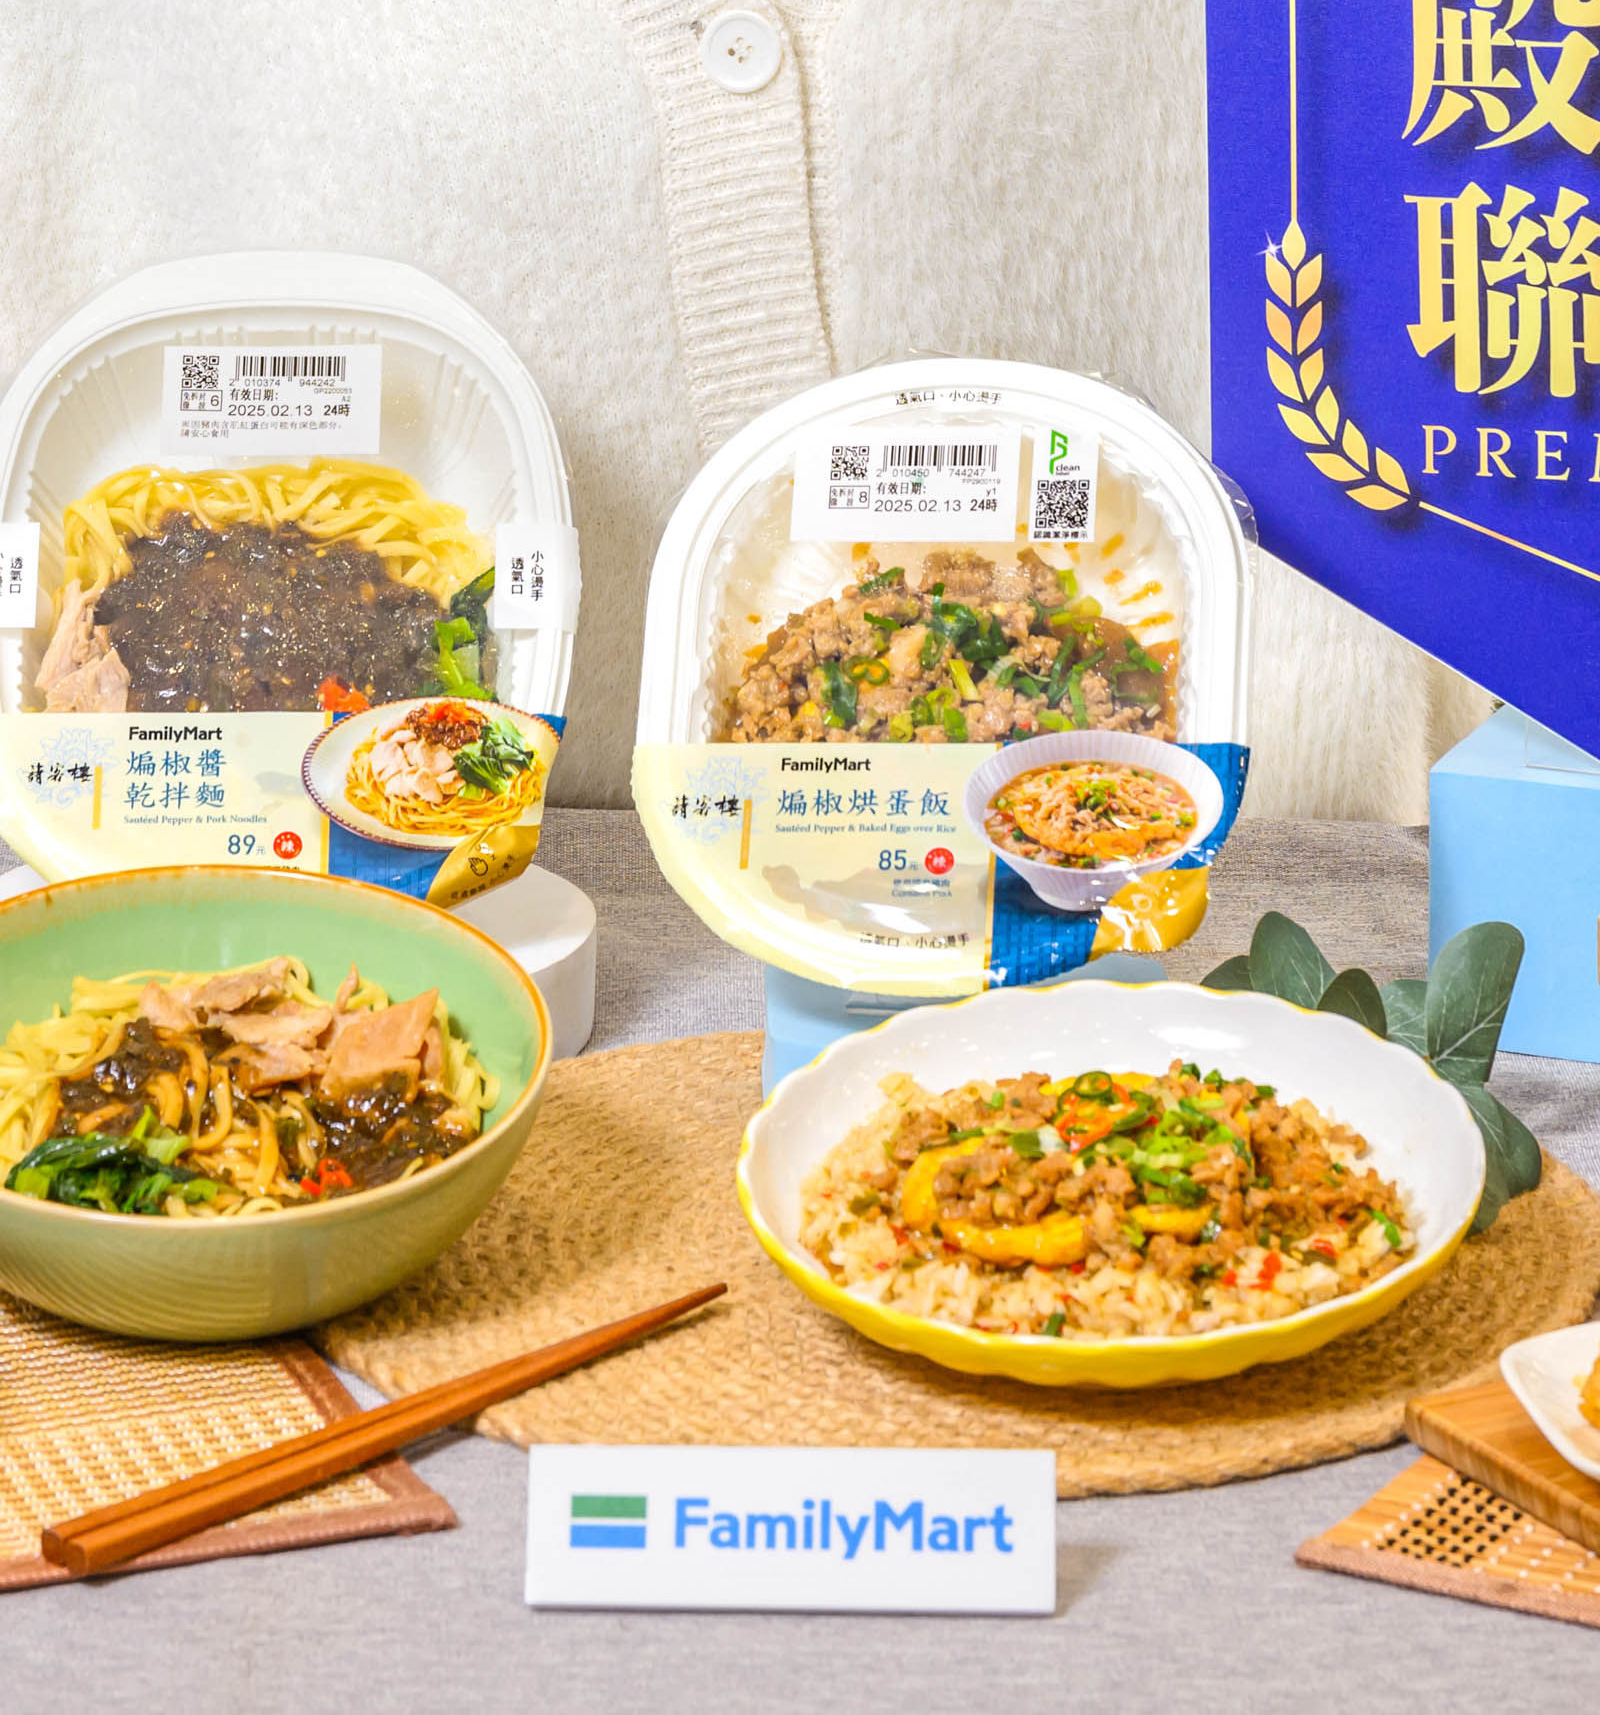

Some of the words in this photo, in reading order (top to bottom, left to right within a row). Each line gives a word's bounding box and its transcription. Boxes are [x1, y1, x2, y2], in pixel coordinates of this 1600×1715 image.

[210, 395, 220, 407] 6
[228, 389, 278, 402] 有效日期:
[227, 404, 313, 417] 2025.02.13
[323, 403, 351, 417] 24時
[875, 482, 927, 496] 有效日期:
[858, 491, 868, 504] 8
[874, 499, 962, 513] 2025.02.13
[969, 498, 998, 512] 24時
[128, 726, 223, 743] FamilyMart
[125, 747, 228, 778] 煸椒醬
[781, 757, 872, 773] FamilyMart
[776, 787, 952, 817] 煸椒烘蛋飯
[206, 814, 228, 824] Pork
[230, 814, 268, 824] Noodles
[936, 824, 956, 834] Rice
[675, 1496, 1014, 1561] FamilyMart
